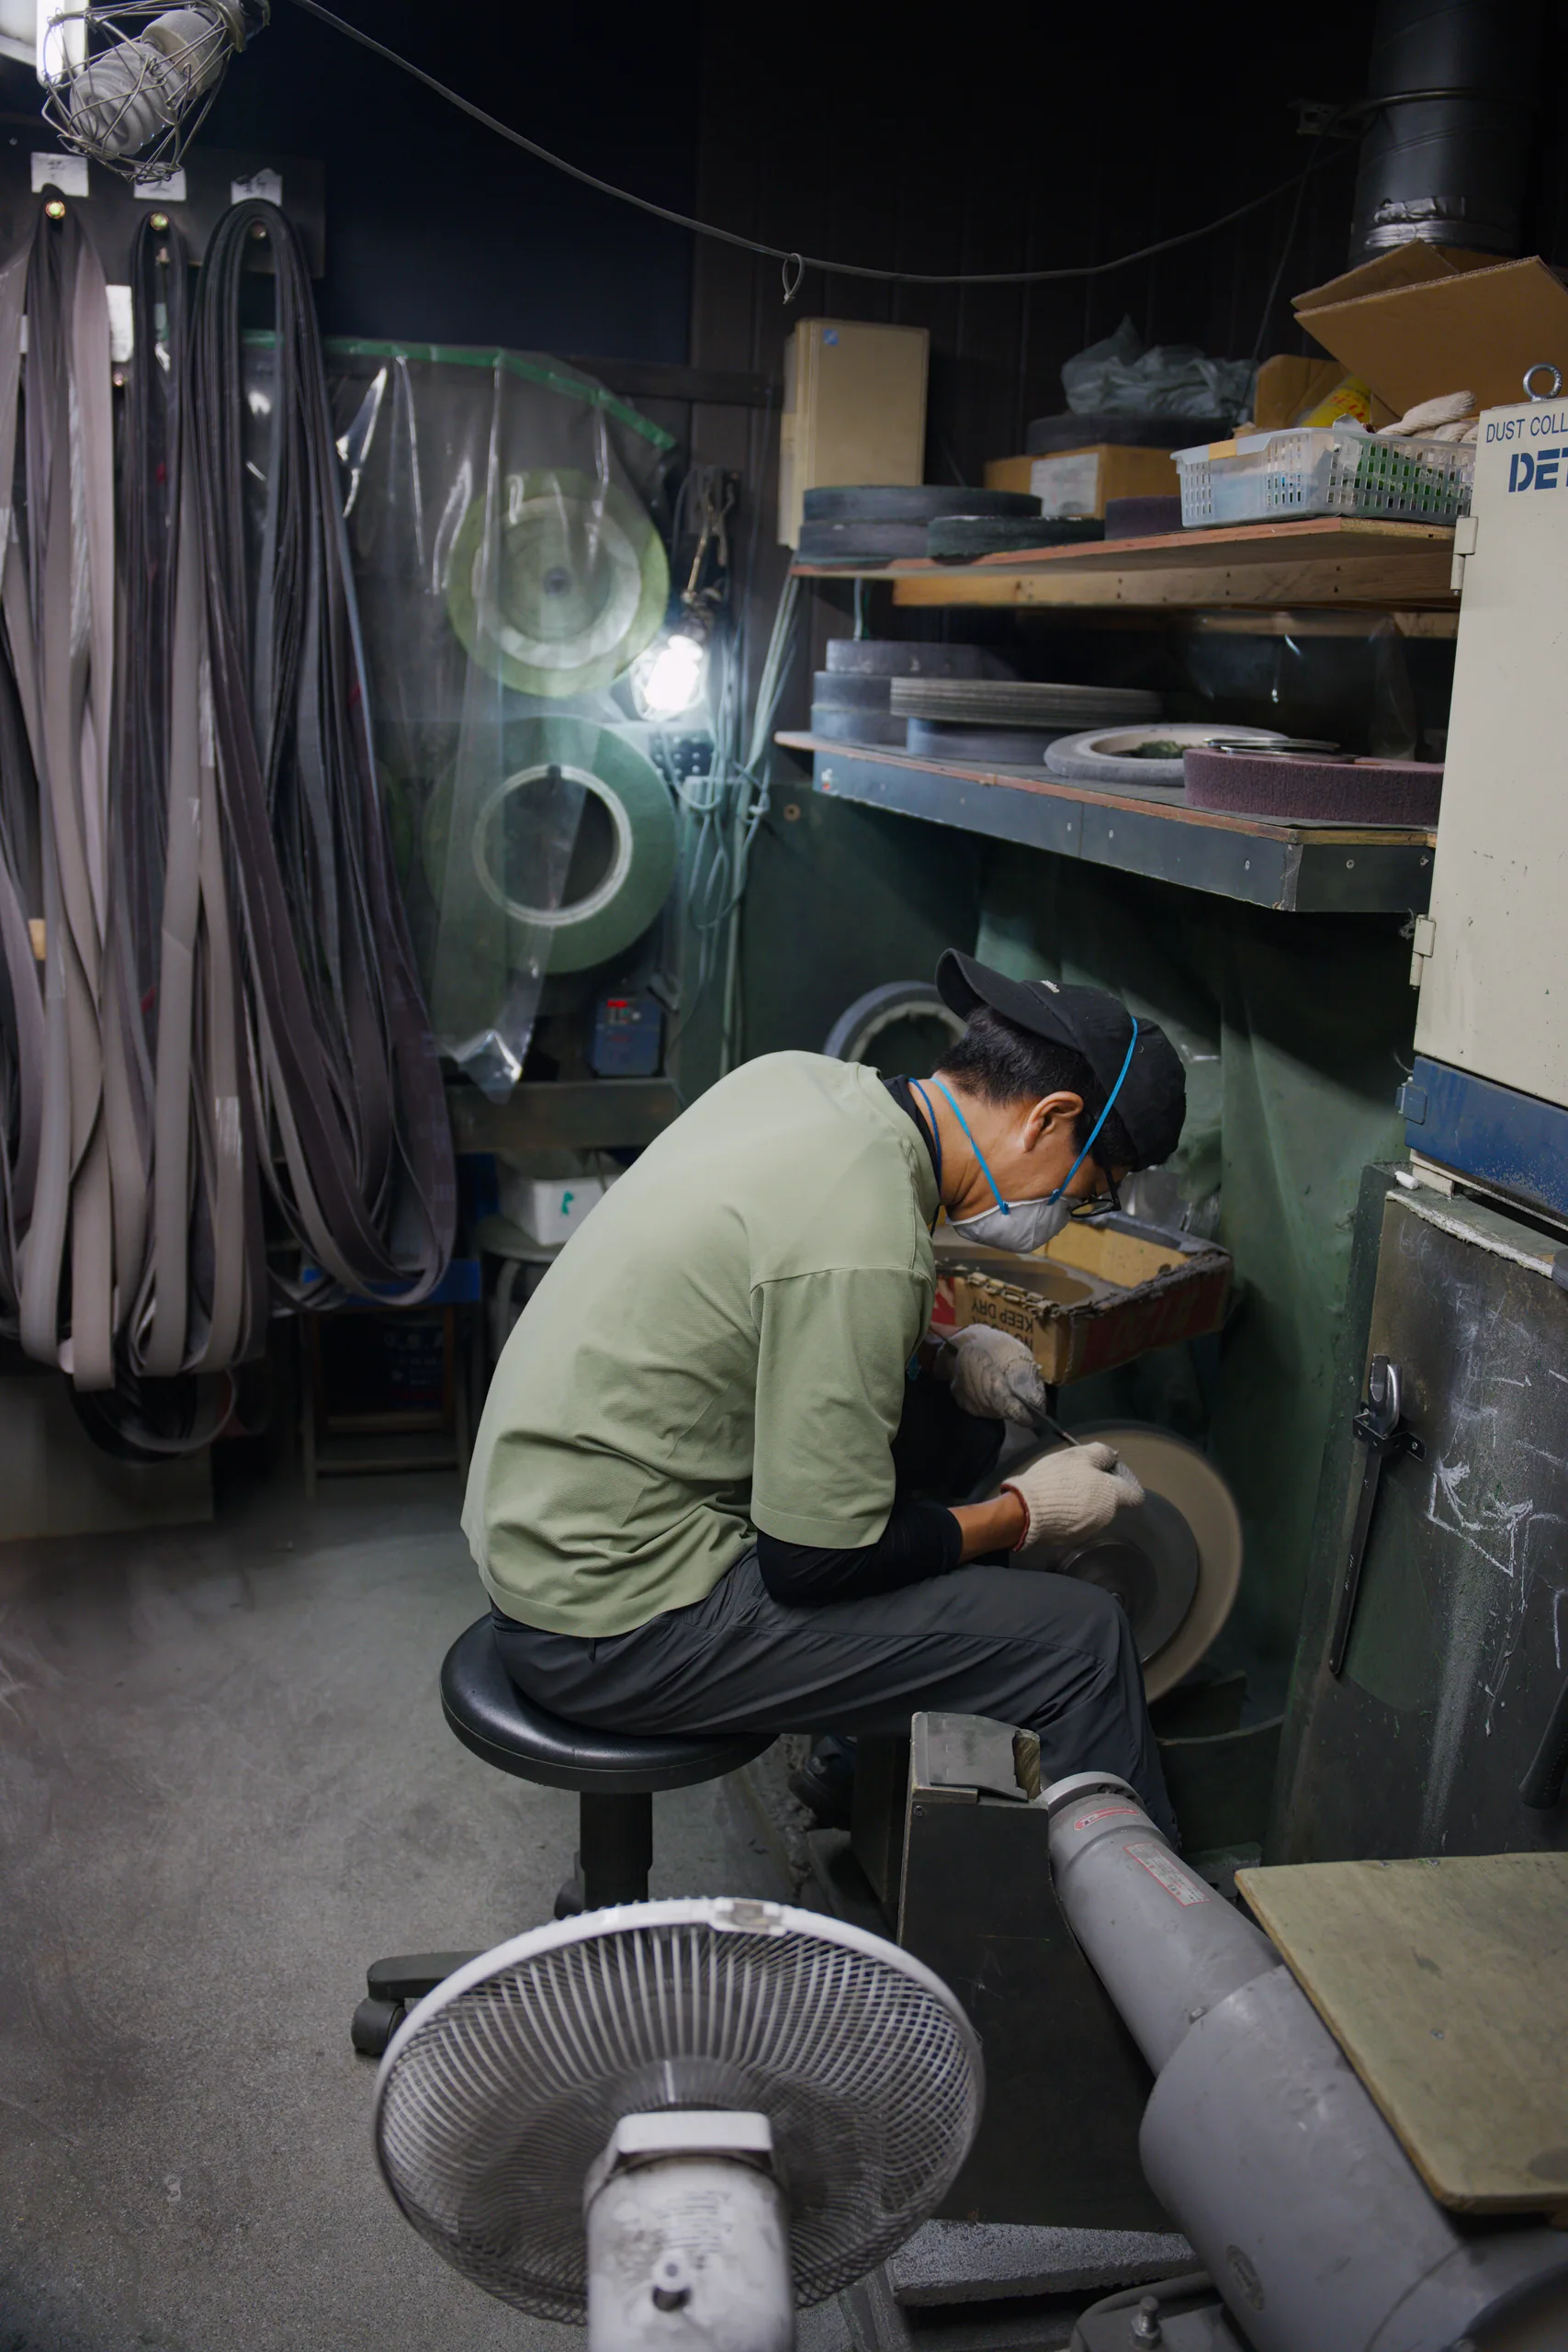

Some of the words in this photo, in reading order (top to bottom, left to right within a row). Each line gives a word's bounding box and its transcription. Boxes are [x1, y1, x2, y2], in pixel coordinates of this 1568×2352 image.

[1486, 418, 1526, 444] DUST
[1508, 447, 1568, 492] DE
[971, 1297, 997, 1320] DRY
[999, 1308, 1033, 1334] KEEP
